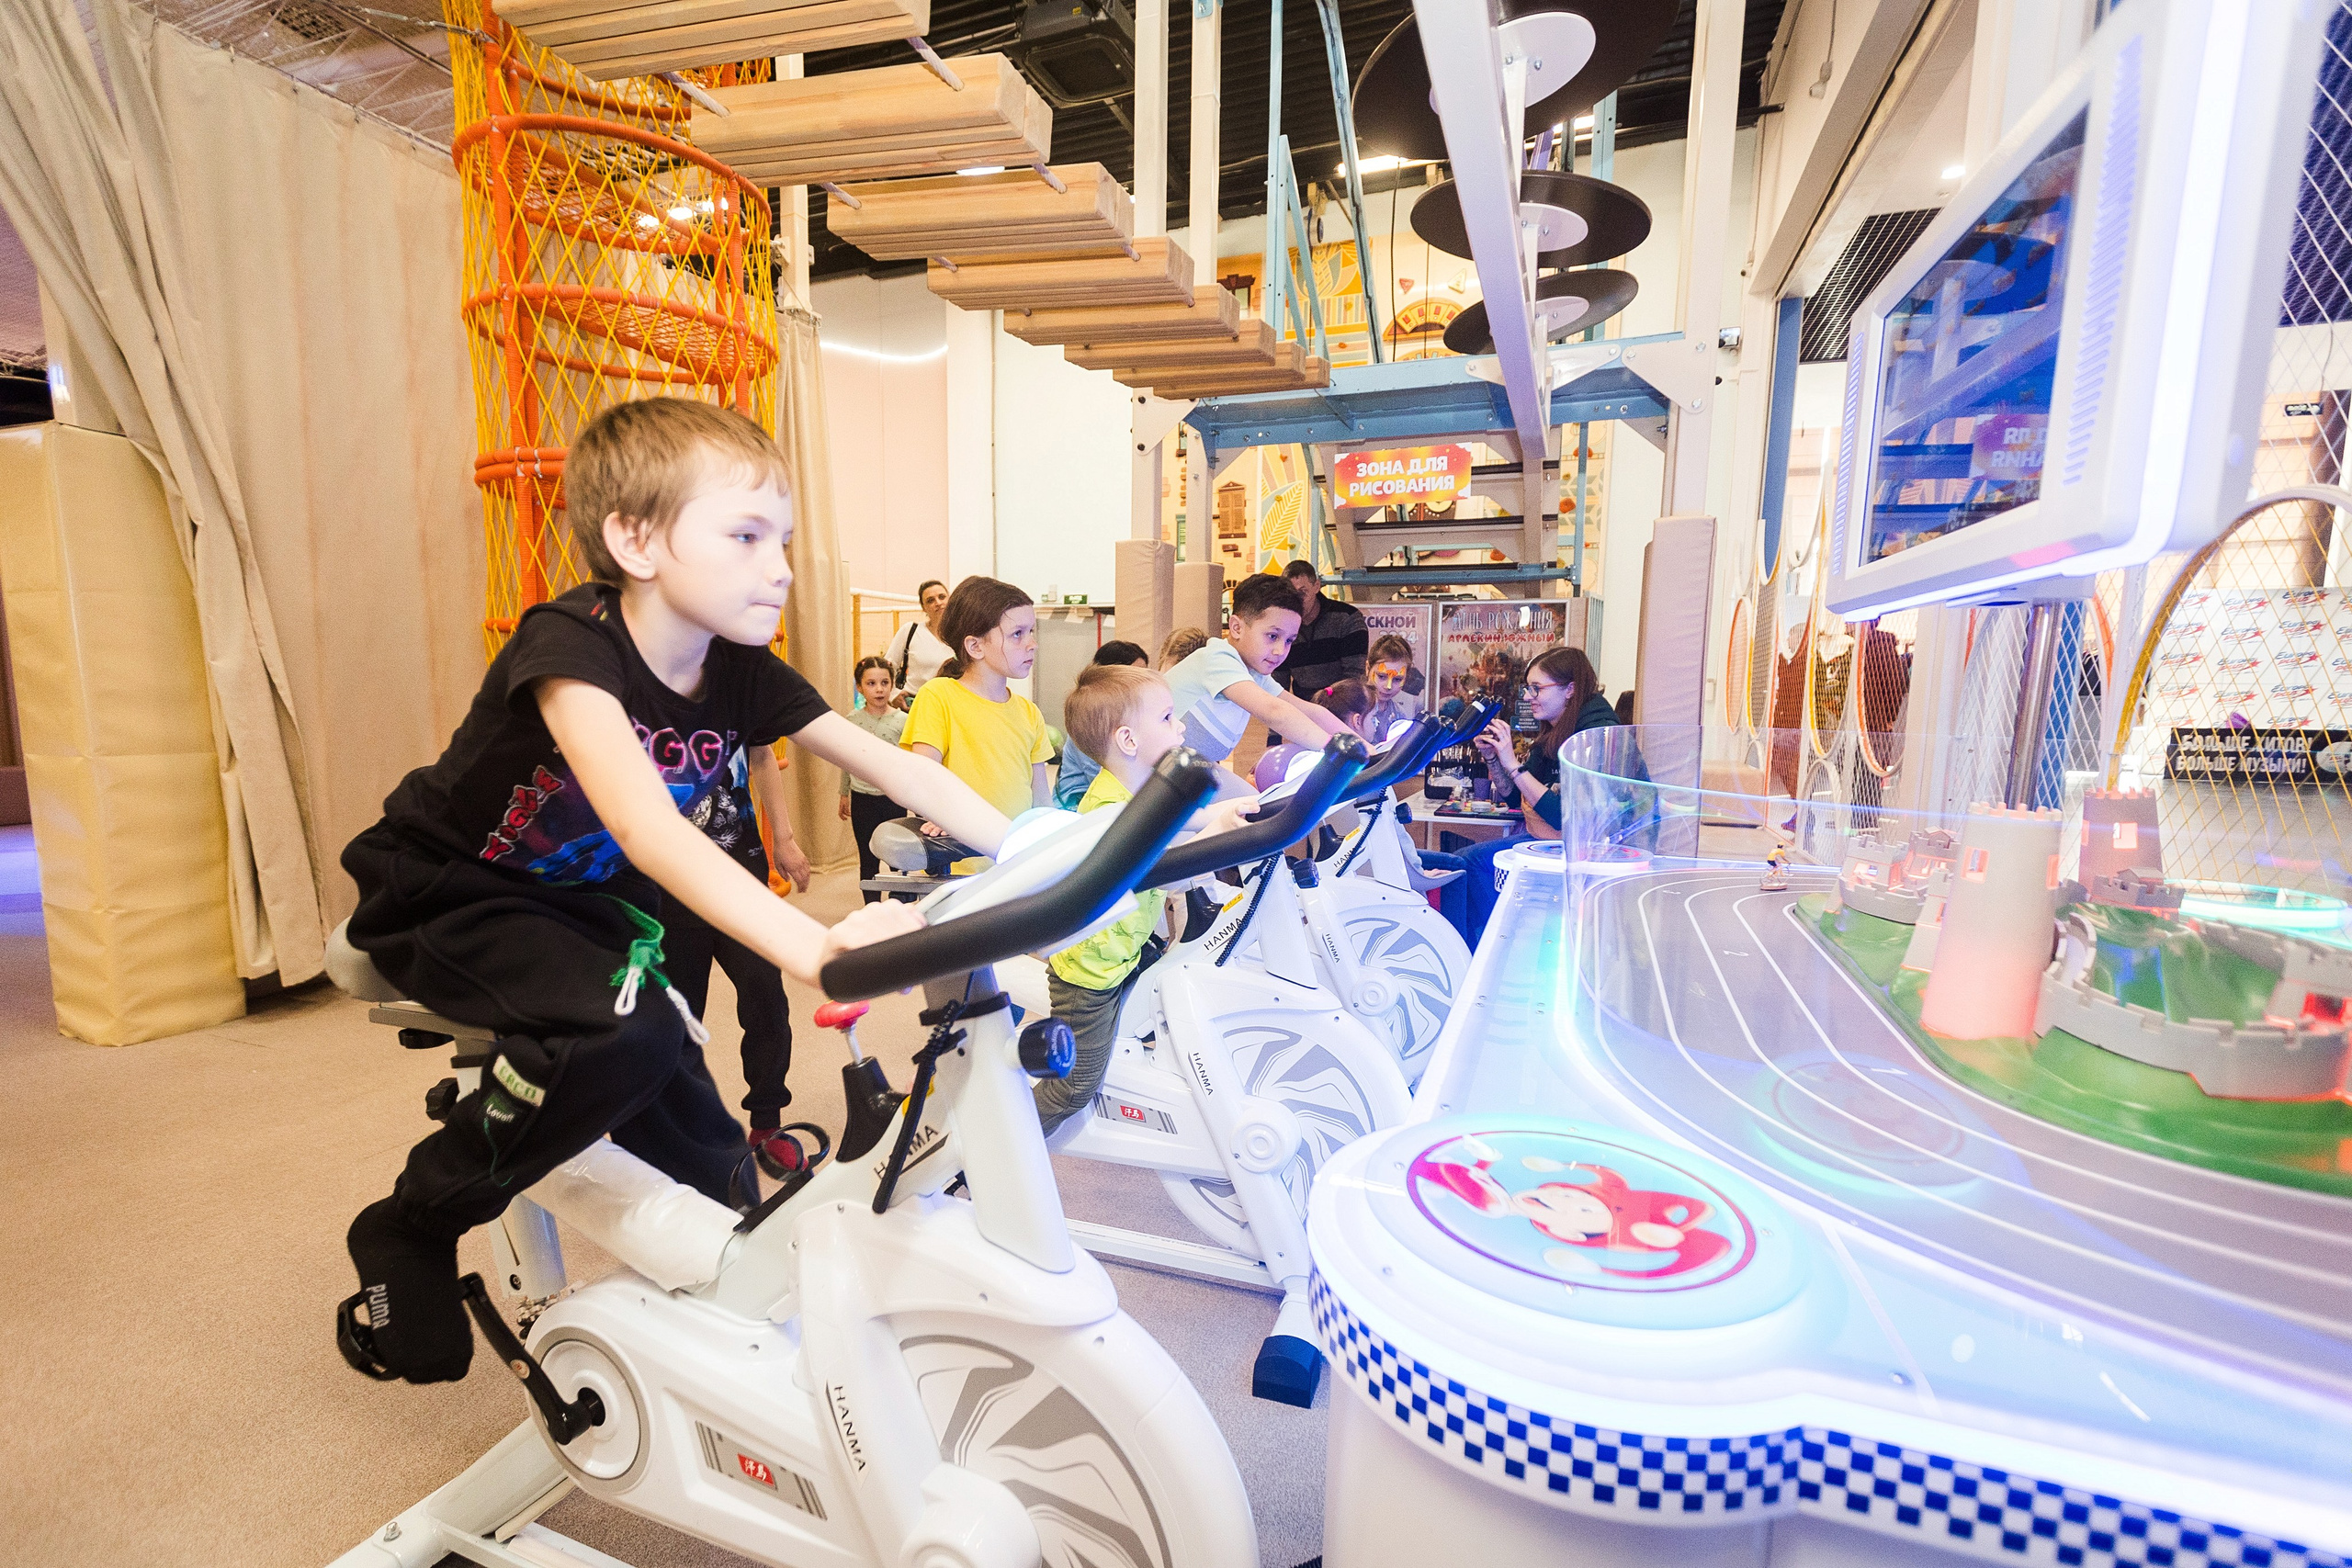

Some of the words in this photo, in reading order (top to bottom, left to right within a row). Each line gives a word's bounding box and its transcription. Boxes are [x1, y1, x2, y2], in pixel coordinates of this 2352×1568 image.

[1356, 460, 1404, 478] ЗОНА
[1407, 456, 1448, 476] ДЛЯ
[1349, 475, 1455, 497] РИСОВАНИЯ
[1364, 613, 1417, 628] СКНОЙ
[1488, 610, 1554, 631] РОЖДНИЯ
[2181, 734, 2251, 752] БОЛЬШЕ
[2175, 755, 2237, 772] БОЛЬШЕ
[1204, 917, 1243, 951] HANMA
[1325, 932, 1340, 964] HANMA
[1193, 1052, 1214, 1096] HANMA
[873, 1124, 938, 1179] HMA
[833, 1385, 866, 1473] HANMA
